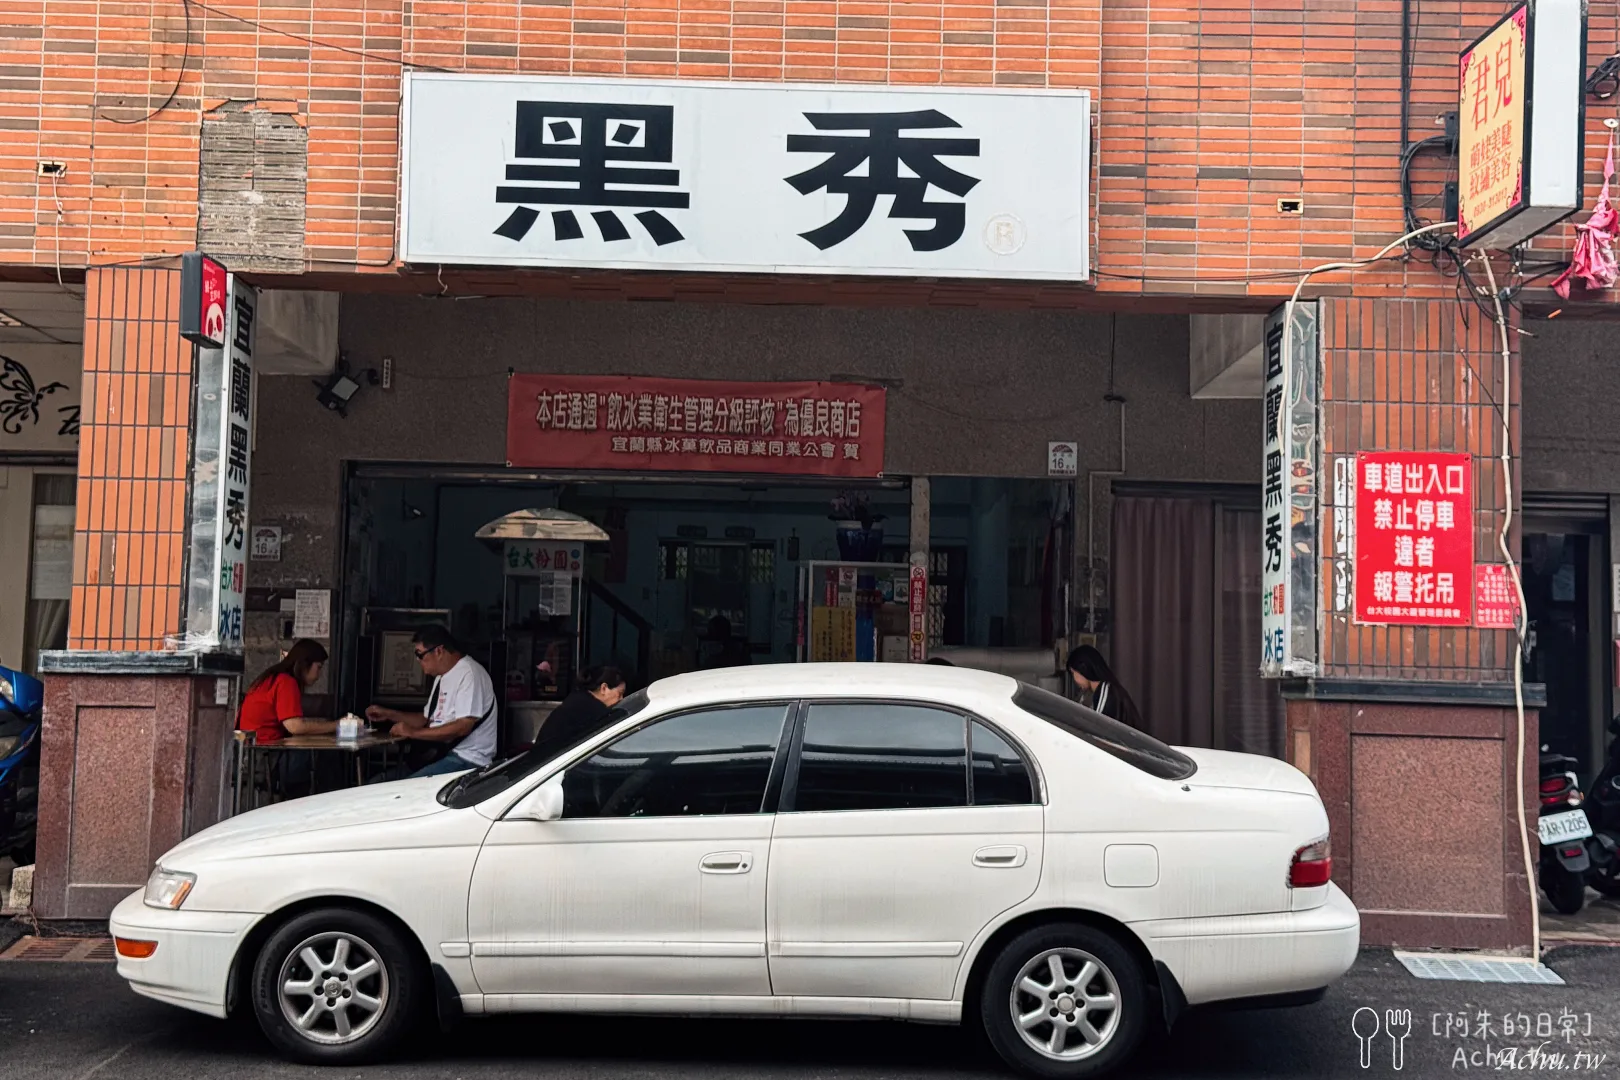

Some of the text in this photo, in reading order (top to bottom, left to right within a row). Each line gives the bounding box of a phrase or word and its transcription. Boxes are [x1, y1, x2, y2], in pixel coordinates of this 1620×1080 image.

[493, 100, 981, 251] 黑秀
[843, 443, 859, 460] 賀
[1364, 461, 1464, 495] 車道出入口
[1373, 498, 1455, 531] 禁止停車
[1393, 534, 1435, 568] 違者
[1373, 570, 1455, 605] 報警托吊
